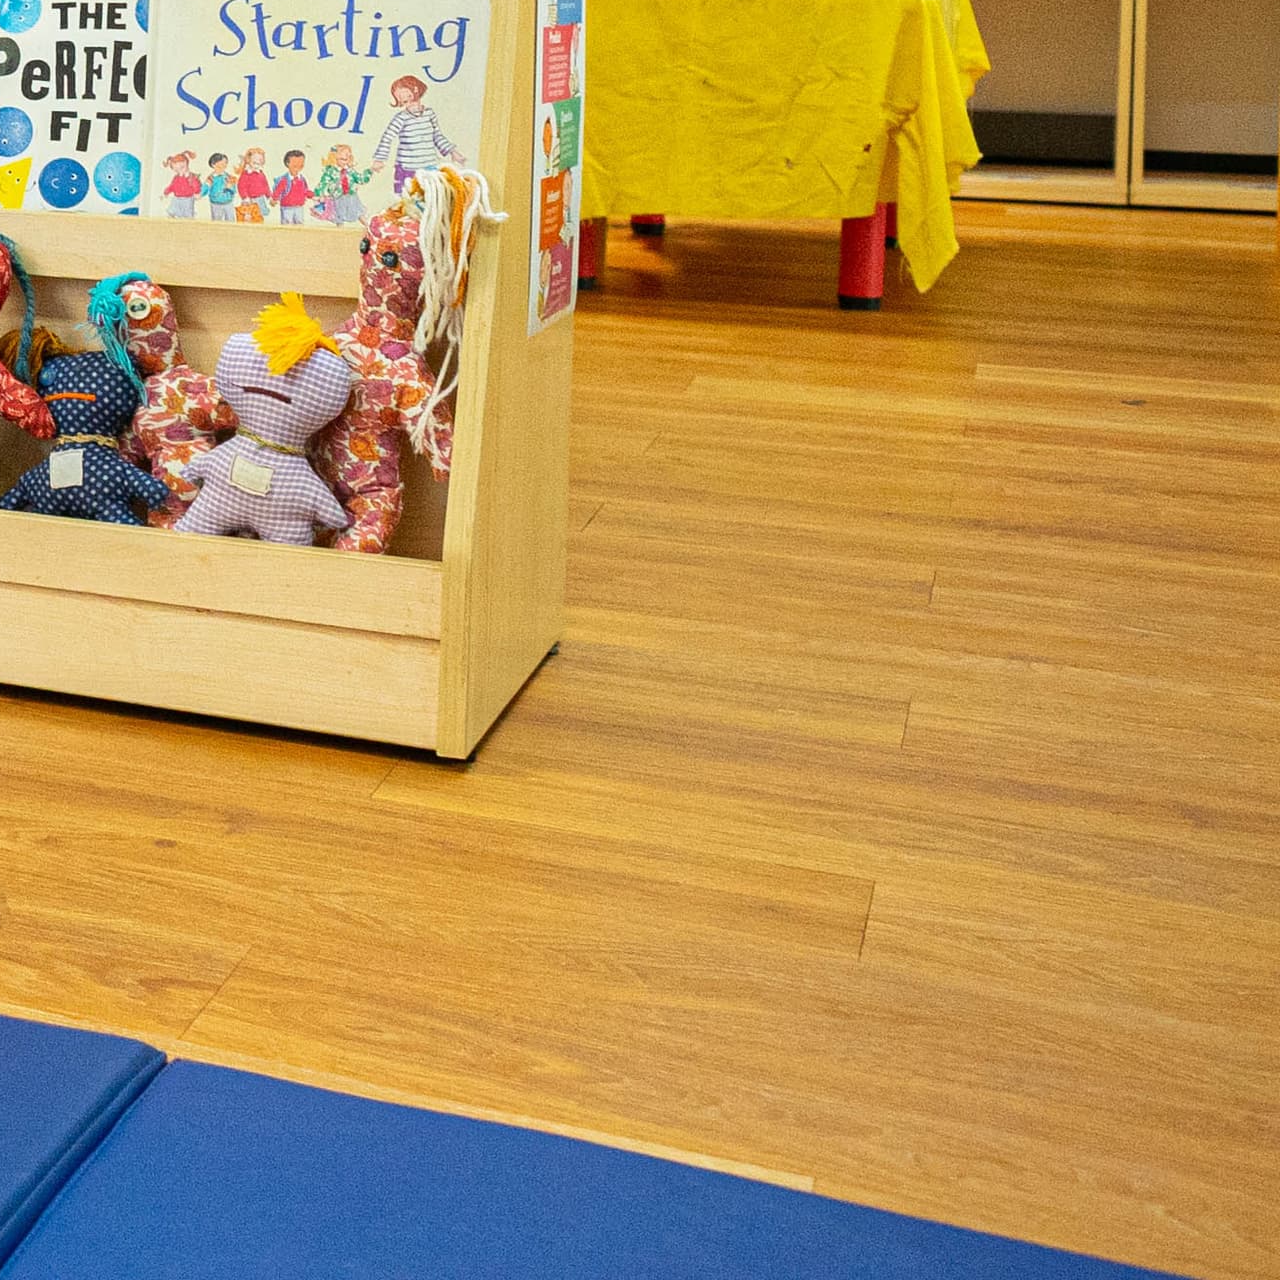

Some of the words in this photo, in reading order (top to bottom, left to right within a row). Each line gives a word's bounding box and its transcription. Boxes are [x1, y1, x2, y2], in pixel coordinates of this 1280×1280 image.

[51, 1, 129, 31] THE
[175, 66, 374, 135] School
[49, 110, 133, 153] FIT
